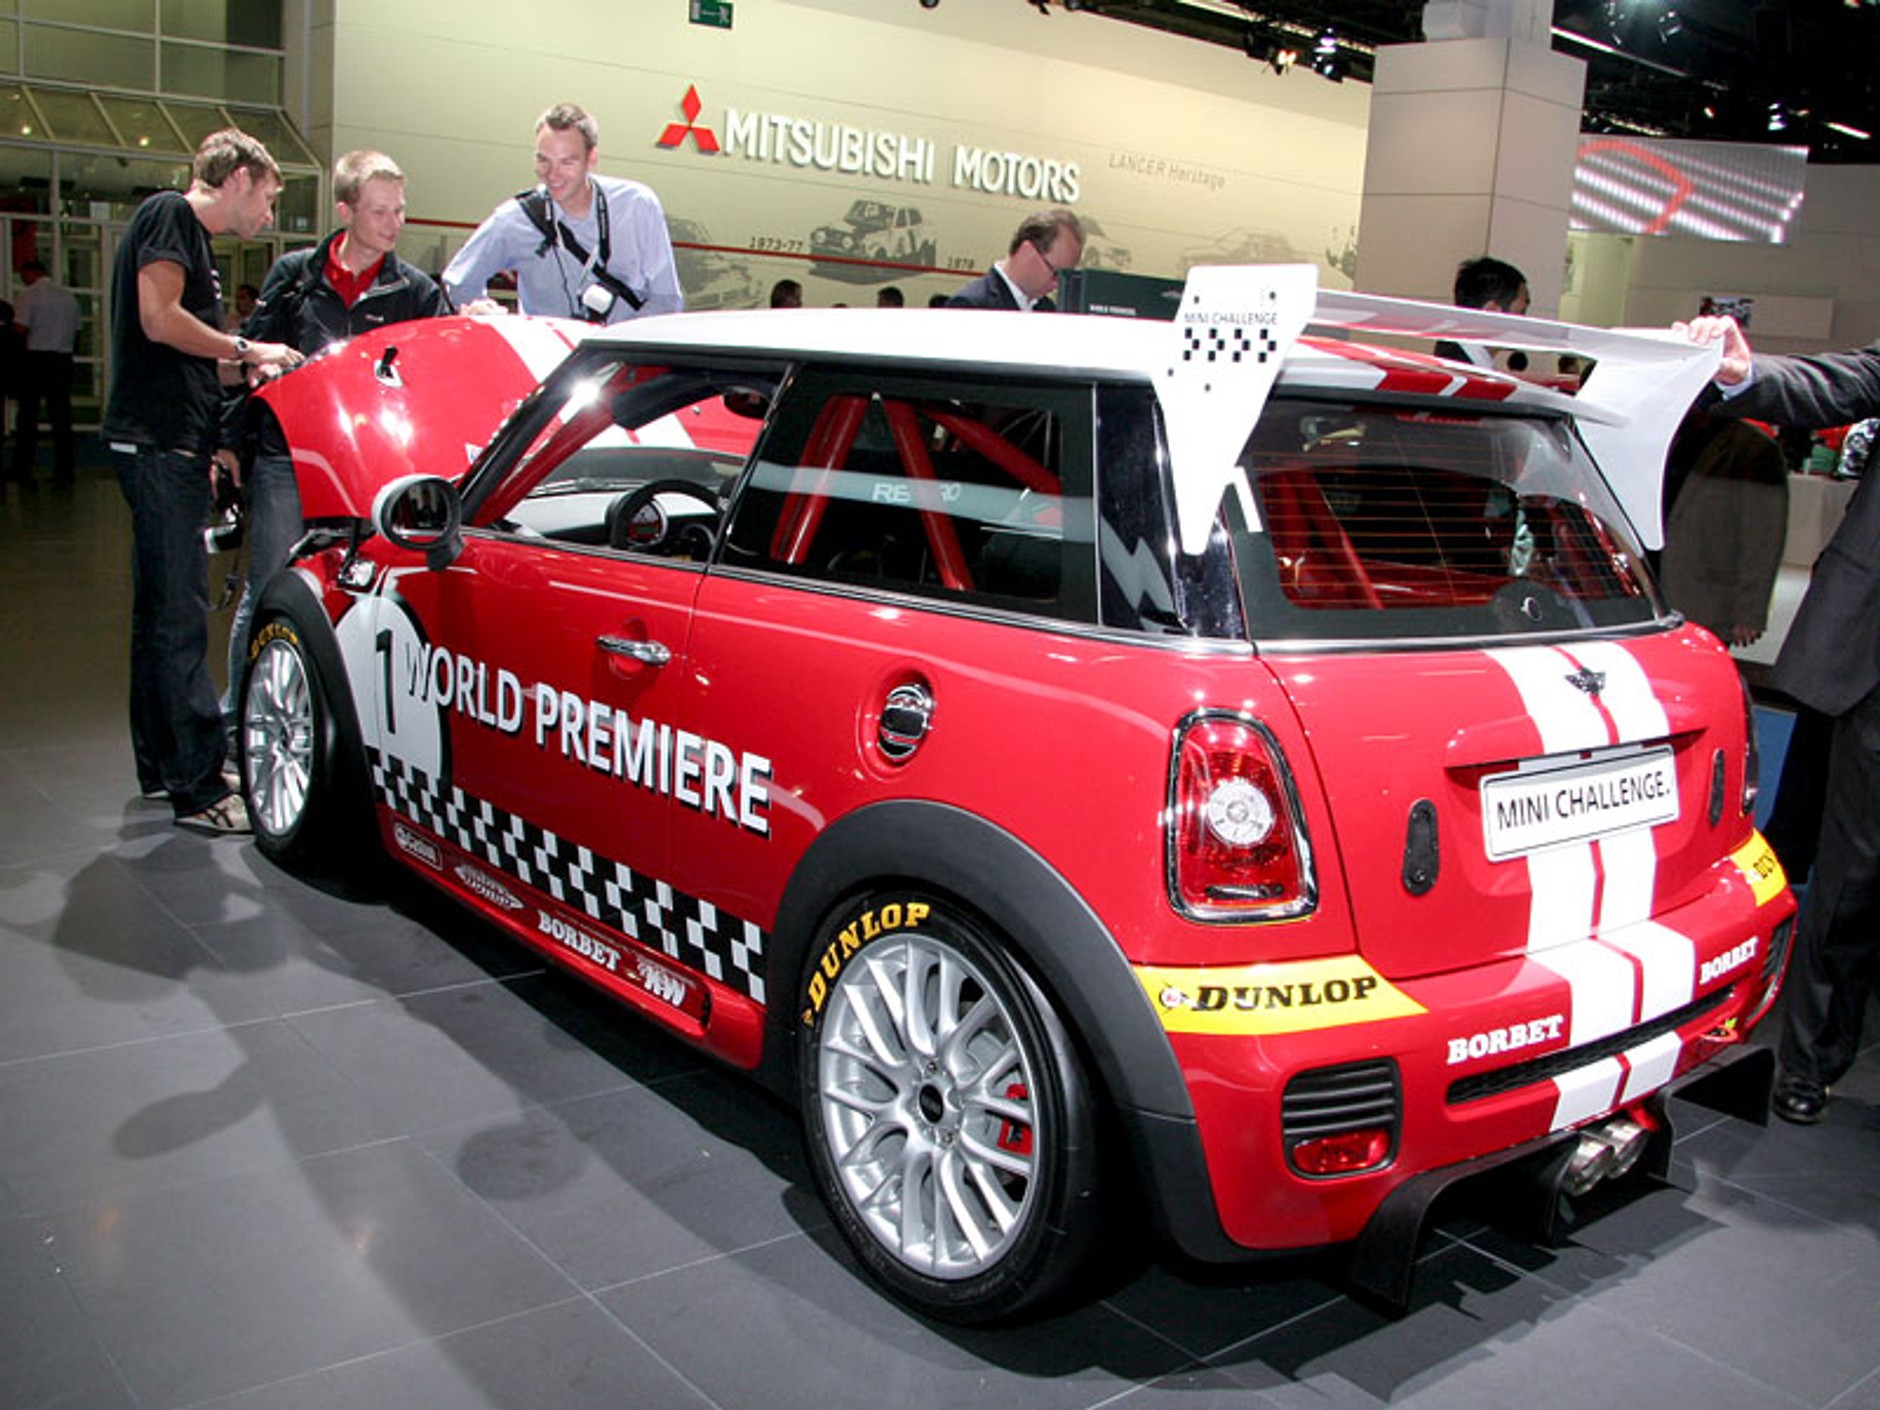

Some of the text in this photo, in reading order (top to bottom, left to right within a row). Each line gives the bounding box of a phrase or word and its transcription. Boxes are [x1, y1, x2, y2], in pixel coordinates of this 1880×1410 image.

[724, 107, 1081, 205] MITSUBISHI MOTORS
[1109, 153, 1226, 190] LANCER Heritage
[1184, 312, 1278, 325] MINI CHALLENGE
[376, 628, 396, 734] 1
[405, 641, 772, 838] WORLD PREMIERE
[1497, 794, 1550, 832] MINI
[538, 910, 621, 971] BORBET
[807, 902, 930, 1012] DUNLOP
[1699, 936, 1758, 985] BORBET
[1191, 975, 1377, 1012] DUNLOP
[1446, 1014, 1564, 1065] BORBET
